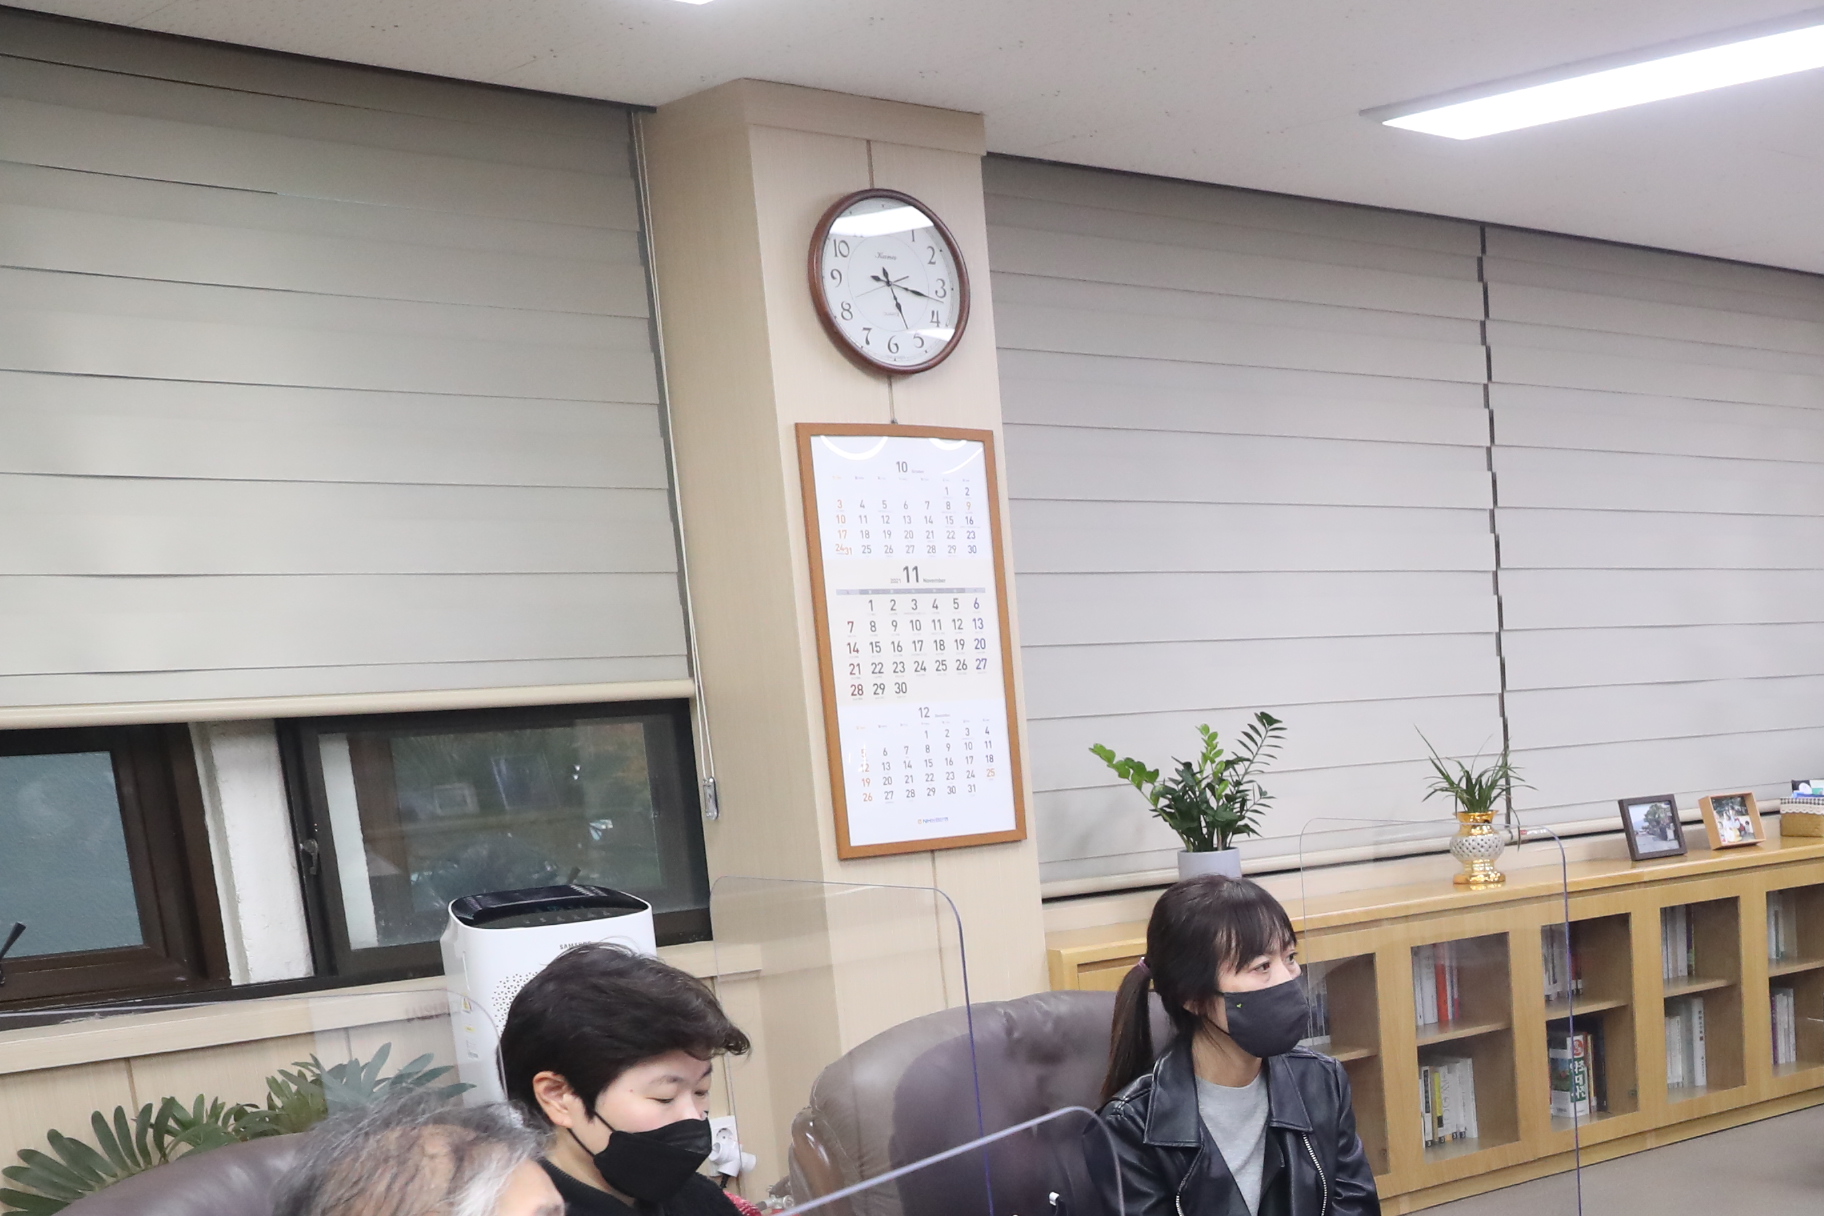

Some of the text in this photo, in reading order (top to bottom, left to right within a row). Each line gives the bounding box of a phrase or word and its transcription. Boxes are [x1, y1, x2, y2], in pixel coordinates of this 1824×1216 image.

[833, 239, 849, 258] 10
[927, 246, 936, 265] 2
[830, 269, 842, 287] 9
[935, 278, 947, 298] 3
[841, 301, 853, 321] 8
[930, 310, 940, 327] 4
[863, 327, 872, 345] 7
[913, 333, 924, 348] 5
[888, 336, 899, 354] 6
[896, 461, 908, 473] 10
[945, 487, 969, 496] 1 2
[837, 499, 971, 510] 3 4 5 6 7 8 9
[836, 514, 974, 525] 10 11 12 13 14 15 16
[838, 530, 976, 539] 17 18 19 20 21 22 23
[862, 545, 872, 554] 25
[884, 545, 893, 554] 26
[905, 545, 915, 554] 27
[927, 545, 936, 554] 28
[948, 545, 956, 554] 29
[968, 545, 977, 554] 30
[903, 566, 919, 583] 11
[869, 598, 979, 611] 1 2 3 4 5 6
[847, 618, 984, 633] 7 8 9 10 11 12 13
[847, 638, 986, 654] 14 15 16 17 18 19 20
[849, 658, 987, 675] 21 22 23 24 25 26 27
[851, 682, 907, 696] 28 29 30
[919, 707, 930, 718] 12
[925, 727, 989, 739] 1 2 3 4
[883, 748, 888, 756] 6
[904, 746, 909, 755] 7
[925, 744, 930, 753] 8
[946, 743, 950, 751] 9
[964, 742, 973, 750] 10
[985, 740, 992, 748] 11
[882, 762, 891, 771] 13
[903, 760, 912, 769] 14
[924, 759, 933, 767] 15
[945, 757, 953, 766] 16
[966, 756, 973, 764] 17
[986, 754, 994, 763] 18
[862, 768, 995, 787] 19 20 21 22 23 24 25
[863, 784, 976, 802] 26 27 28 29 30 31
